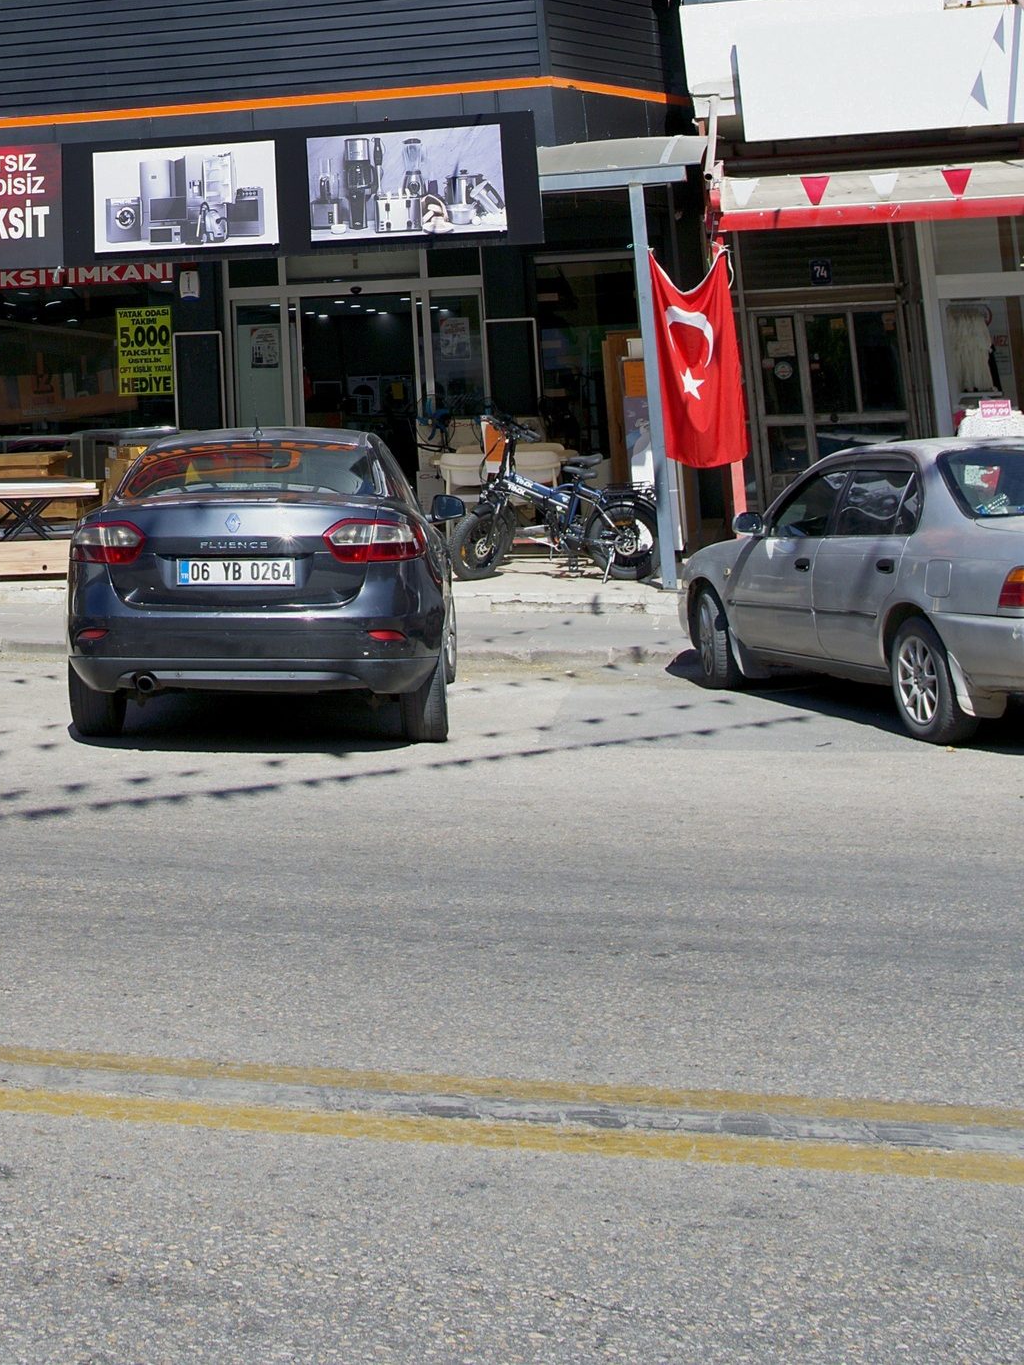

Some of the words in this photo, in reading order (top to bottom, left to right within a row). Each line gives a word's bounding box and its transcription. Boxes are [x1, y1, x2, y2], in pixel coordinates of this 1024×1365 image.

[814, 266, 827, 278] 74
[119, 310, 143, 318] YATAK
[145, 309, 169, 317] ODASI
[130, 318, 157, 326] TAKIMI
[120, 325, 170, 348] 5.000
[120, 348, 170, 356] TAKSİTLE
[121, 374, 171, 392] HEDİYE
[200, 541, 268, 549] FLUENCE
[191, 562, 210, 581] 06
[223, 562, 242, 581] YB
[250, 562, 291, 580] 0264
